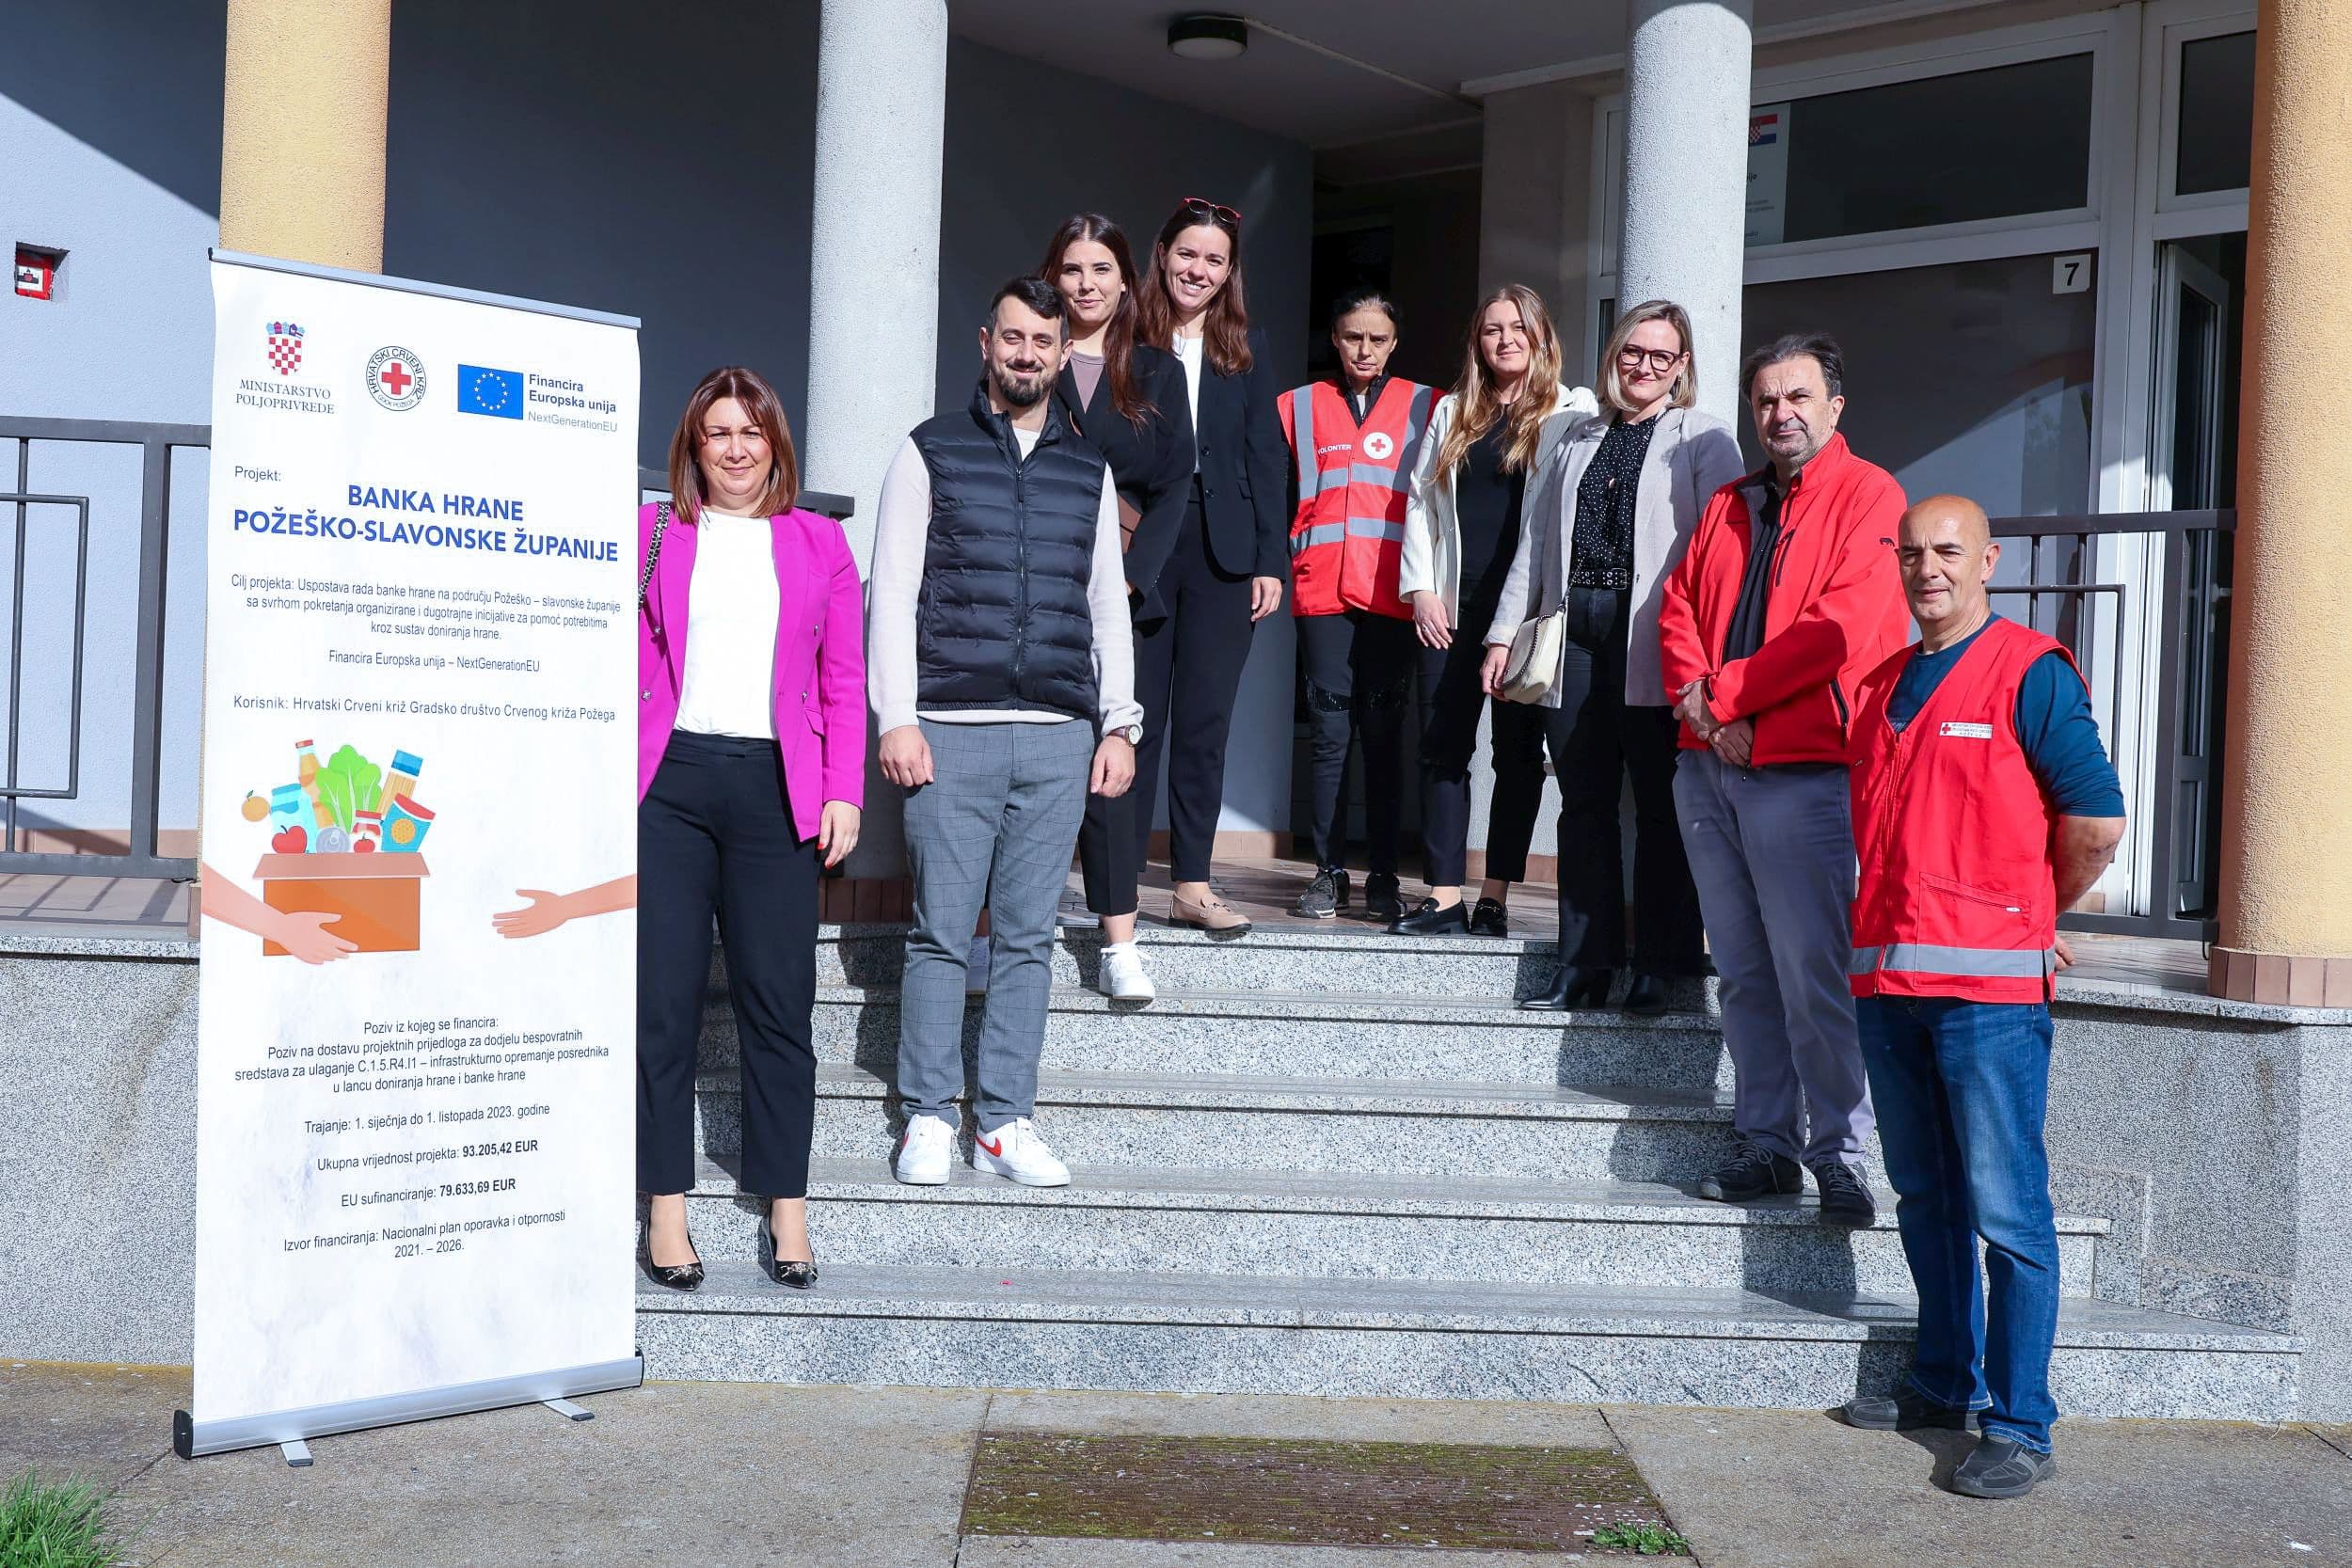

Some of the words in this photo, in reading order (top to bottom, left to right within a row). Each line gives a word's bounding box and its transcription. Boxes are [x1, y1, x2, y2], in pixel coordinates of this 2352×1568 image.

[2064, 262, 2080, 286] 7
[368, 349, 390, 394] HRVATSKI
[391, 348, 422, 374] CRVENI
[529, 373, 584, 393] Financira
[239, 378, 331, 400] MINISTARSTVO
[529, 388, 585, 409] Europska
[588, 400, 617, 415] unija
[235, 392, 335, 415] POLJOPRIVREDE
[528, 410, 618, 434] NextGenerationEU
[234, 465, 281, 483] Projekt:
[348, 484, 437, 514] BANKA
[443, 493, 524, 522] HRANE
[233, 509, 507, 553] POŽEŠKO-SLAVONSKE
[513, 532, 618, 562] ŽUPANIJE
[230, 573, 247, 592] Cilj
[249, 576, 294, 593] projekta:
[297, 578, 350, 594] Uspostava
[352, 582, 373, 595] rada
[375, 582, 406, 598] banke
[408, 585, 436, 599] hrane
[437, 589, 450, 601] na
[452, 589, 492, 606] području
[494, 591, 532, 607] Požeško
[542, 595, 585, 610] slavonske
[586, 597, 621, 615] županije
[246, 596, 259, 609] sa
[261, 595, 301, 610] svrhom
[303, 596, 356, 616] pokretanja
[356, 601, 416, 618] organizirane
[422, 605, 473, 623] dugotrajne
[475, 609, 516, 625] inicijative
[516, 613, 528, 624] za
[530, 613, 562, 627] pomoć
[563, 616, 608, 629] potrebitima
[371, 620, 392, 635] kroz
[394, 624, 425, 636] sustav
[427, 624, 471, 641] doniranja
[473, 626, 502, 641] hrane.
[328, 649, 373, 665] Financira
[375, 652, 421, 669] Europska
[422, 655, 446, 671] unija
[456, 656, 540, 673] NextGenerationEU
[233, 694, 289, 710] Korisnik:
[293, 696, 341, 712] Hrvatski
[343, 698, 382, 713] Crveni
[386, 699, 406, 714] križ
[409, 700, 457, 716] Gradsko
[460, 703, 501, 717] društvo
[503, 704, 548, 721] Crvenog
[550, 706, 577, 720] križa
[580, 706, 615, 723] Požega
[363, 1021, 393, 1036] Poziv
[395, 1020, 405, 1034] iz
[407, 1019, 436, 1036] kojeg
[437, 1020, 451, 1031] se
[453, 1016, 499, 1030] financira:
[267, 1045, 298, 1060] Poziv
[300, 1046, 314, 1058] na
[317, 1043, 360, 1057] dostavu
[362, 1038, 414, 1057] projektnih
[417, 1036, 467, 1053] prijedloga
[469, 1037, 482, 1048] za
[484, 1032, 520, 1049] dodjelu
[522, 1028, 583, 1046] bespovratnih
[234, 1067, 290, 1082] sredstava
[292, 1067, 306, 1078] za
[309, 1060, 355, 1078] ulaganje
[358, 1056, 417, 1073] C.1.5.R4.I1
[430, 1053, 502, 1069] infrastrukturno
[504, 1048, 555, 1066] opremanje
[557, 1045, 610, 1062] posrednika
[342, 1080, 373, 1093] lancu
[374, 1075, 423, 1092] doniranja
[426, 1073, 456, 1087] hrane
[464, 1069, 495, 1085] banke
[497, 1069, 527, 1082] hrane
[304, 1118, 352, 1137] Trajanje:
[355, 1117, 365, 1130] 1.
[367, 1114, 407, 1132] siječnja
[409, 1113, 423, 1128] do
[426, 1111, 436, 1124] 1.
[438, 1107, 485, 1125] listopada
[486, 1105, 515, 1119] 2023.
[516, 1103, 550, 1120] godine
[317, 1158, 359, 1173] Ukupna
[362, 1150, 414, 1169] vrijednost
[415, 1147, 460, 1165] projekta:
[462, 1141, 513, 1158] 93.205,42
[515, 1139, 539, 1153] EUR
[341, 1193, 358, 1208] EU
[360, 1186, 437, 1206] sufinanciranje:
[439, 1180, 490, 1197] 79.633,69
[492, 1178, 516, 1193] EUR
[284, 1238, 311, 1253] Izvor
[313, 1229, 379, 1249] financiranja:
[382, 1222, 437, 1242] Nacionalni
[439, 1221, 461, 1238] plan
[463, 1215, 510, 1234] oporavka
[517, 1208, 565, 1227] otpornosti
[394, 1243, 424, 1259] 2021.
[436, 1238, 465, 1254] 2026.
